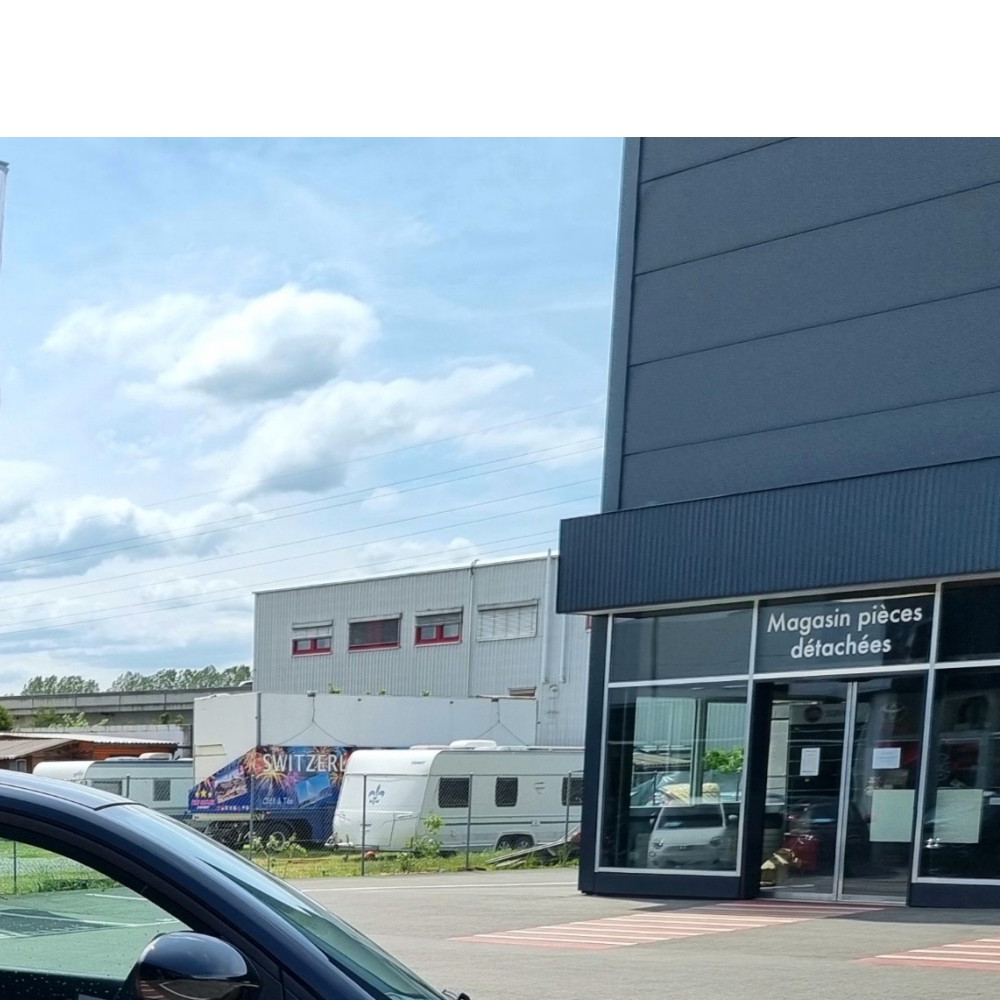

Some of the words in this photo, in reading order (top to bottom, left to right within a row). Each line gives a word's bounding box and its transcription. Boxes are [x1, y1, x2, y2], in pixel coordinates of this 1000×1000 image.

[767, 608, 851, 636] Magasin
[857, 603, 923, 632] pièces
[791, 633, 892, 659] détachées
